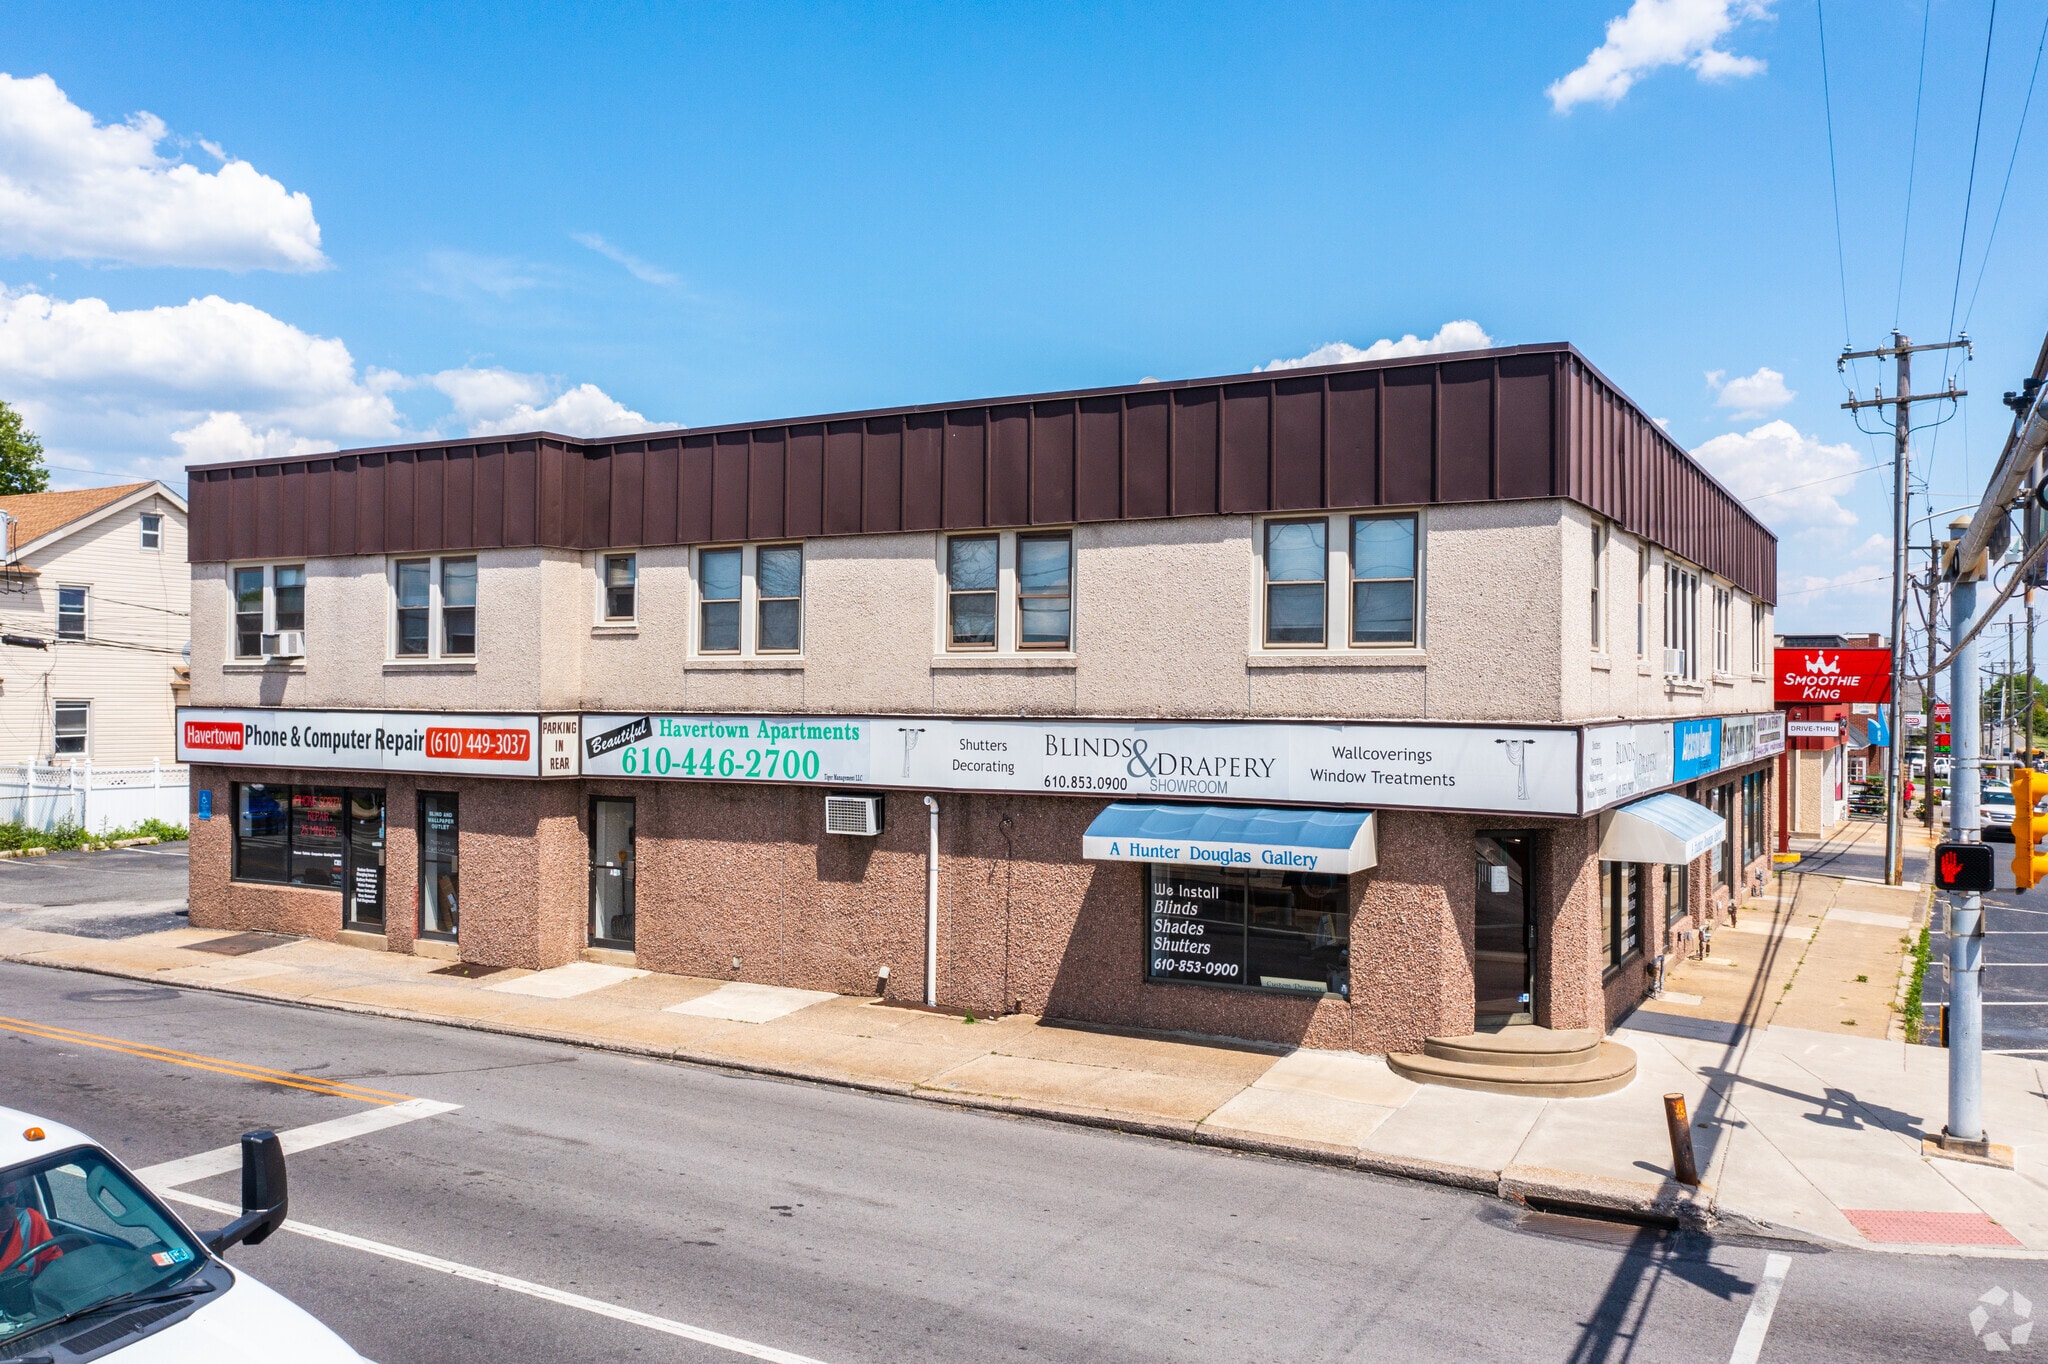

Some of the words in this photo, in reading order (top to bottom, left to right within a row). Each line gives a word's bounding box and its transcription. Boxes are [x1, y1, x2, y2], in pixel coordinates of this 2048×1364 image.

[1784, 672, 1861, 686] SMOOTHIE
[542, 721, 577, 735] PARKING
[590, 719, 647, 754] Beautiful
[659, 719, 750, 738] Havertown
[757, 719, 860, 745] Apartments
[1790, 725, 1837, 733] DRIVE-THRU
[187, 725, 241, 745] Havertown
[245, 724, 287, 747] Phone
[290, 726, 301, 747] &
[304, 726, 371, 754] Computer
[375, 728, 425, 756] Repair
[430, 731, 463, 756] (610)
[466, 733, 527, 755] 449-3037
[555, 739, 564, 753] IN
[959, 738, 1008, 752] Shutters
[550, 757, 570, 770] REAR
[621, 746, 820, 780] 610-446-2700
[1044, 734, 1133, 758] BLINDS
[1126, 738, 1158, 778] &
[1157, 752, 1276, 778] DRAPERY
[1332, 746, 1433, 765] Wallcoverings
[952, 758, 1015, 775] Decorating
[1043, 775, 1128, 791] 610.853.0900
[1149, 777, 1228, 794] SHOWROOM
[1310, 768, 1366, 783] Window
[1371, 770, 1456, 787] Treatments
[307, 810, 330, 822] REPAIR
[427, 817, 455, 825] WALLPAPER
[1110, 841, 1121, 856] A
[1129, 842, 1180, 859] Hunter
[1190, 846, 1251, 866] Douglas
[1262, 850, 1318, 870] Gallery
[1154, 883, 1174, 896] We
[1179, 884, 1220, 900] Install
[1154, 900, 1198, 916] Blinds
[1153, 919, 1204, 936] Shades
[1153, 937, 1211, 954] Shutters
[1154, 958, 1239, 977] 610-853-0900
